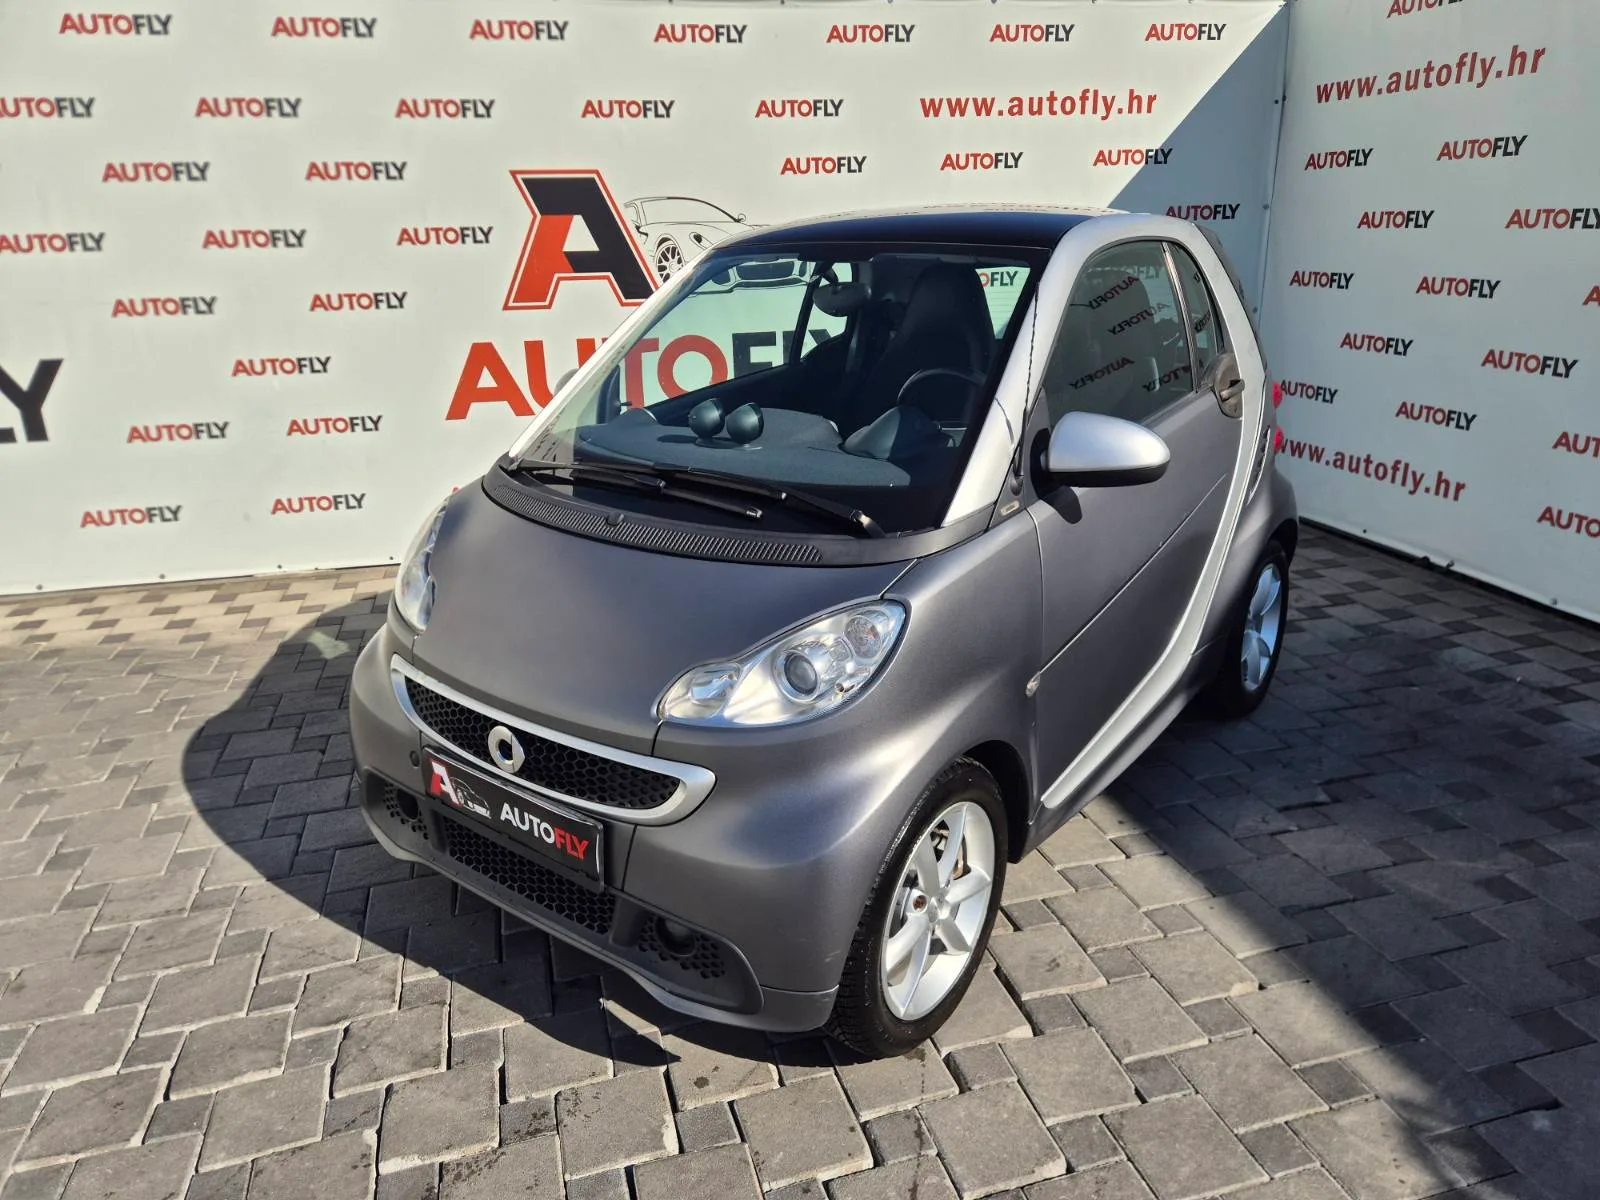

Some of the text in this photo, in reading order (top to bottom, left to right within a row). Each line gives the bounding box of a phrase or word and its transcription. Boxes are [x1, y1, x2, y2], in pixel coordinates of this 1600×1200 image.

[59, 14, 172, 35] AUTOFLY
[272, 17, 377, 38] AUTOFLY
[470, 20, 568, 40] AUTOFLY
[654, 24, 747, 43] AUTOFLY
[826, 24, 915, 43] AUTOFLY
[990, 24, 1075, 42] AUTOFLY
[1145, 23, 1226, 41] AUTOFLY
[1317, 45, 1545, 104] www.autofly.hr
[0, 97, 94, 118] UTOFLY
[195, 98, 301, 118] AUTOFLY
[396, 99, 495, 118] AUTOFLY
[581, 100, 675, 118] AUTOFLY
[755, 99, 843, 118] AUTOFLY
[920, 89, 1156, 120] www.autofly.hr
[1093, 148, 1173, 167] AUTOFLY
[1437, 135, 1528, 161] AUTOFLY
[781, 156, 867, 175] AUTOFLY
[940, 152, 1023, 171] AUTOFLY
[1304, 148, 1373, 170] AUTOFLY
[102, 162, 210, 182] AUTOFLY
[305, 162, 407, 181] AUTOFLY
[1166, 204, 1240, 221] AUTOFLY
[1357, 210, 1434, 229] AUTOFLY
[0, 232, 105, 253] AUTOFLY
[203, 229, 306, 249] AUTOFLY
[397, 226, 493, 245] AUTOFLY
[1290, 271, 1354, 289] AUTOFLY
[1416, 276, 1501, 299] AUTOFLY
[112, 296, 217, 318] AUTOFLY
[310, 292, 407, 311] AUTOFLY
[1340, 333, 1413, 356] AUTOFLY
[232, 356, 331, 376] AUTOFLY
[1481, 349, 1578, 378] AUTOFLY
[287, 415, 382, 436] AUTOFLY
[1396, 402, 1477, 431] AUTOFLY
[127, 421, 229, 443] AUTOFLY
[271, 493, 366, 515] AUTOFLY
[80, 505, 182, 528] AUTOFLY
[500, 803, 588, 860] AUTOFLY
